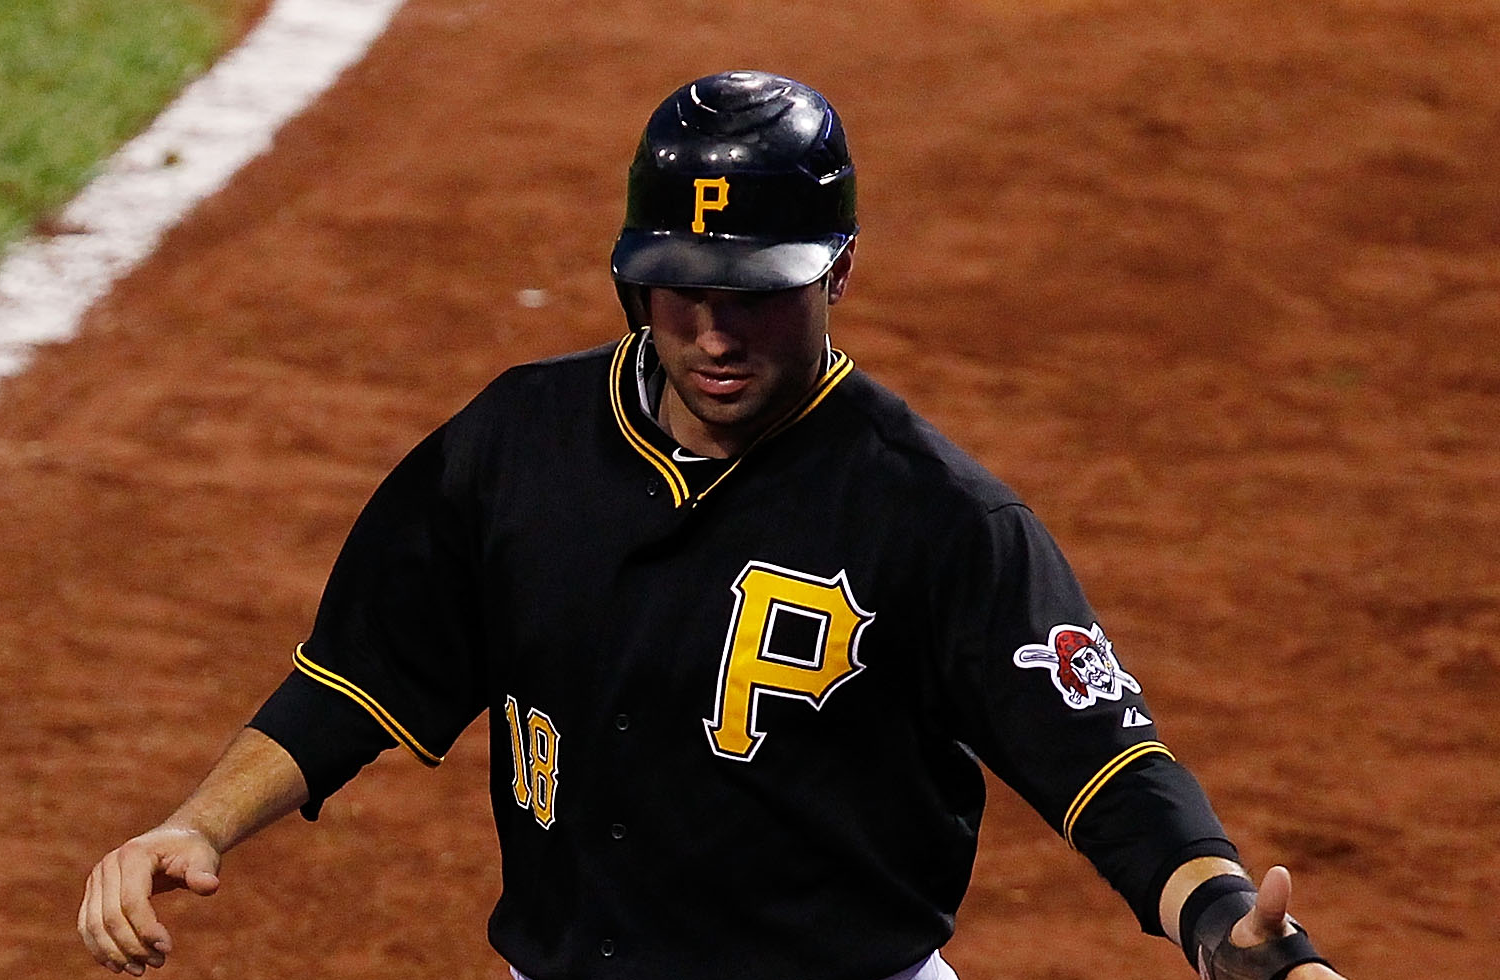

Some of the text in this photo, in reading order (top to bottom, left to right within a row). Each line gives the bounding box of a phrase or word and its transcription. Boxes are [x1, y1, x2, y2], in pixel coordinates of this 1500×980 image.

[692, 176, 730, 233] P
[703, 560, 876, 761] P
[504, 694, 560, 829] 18
